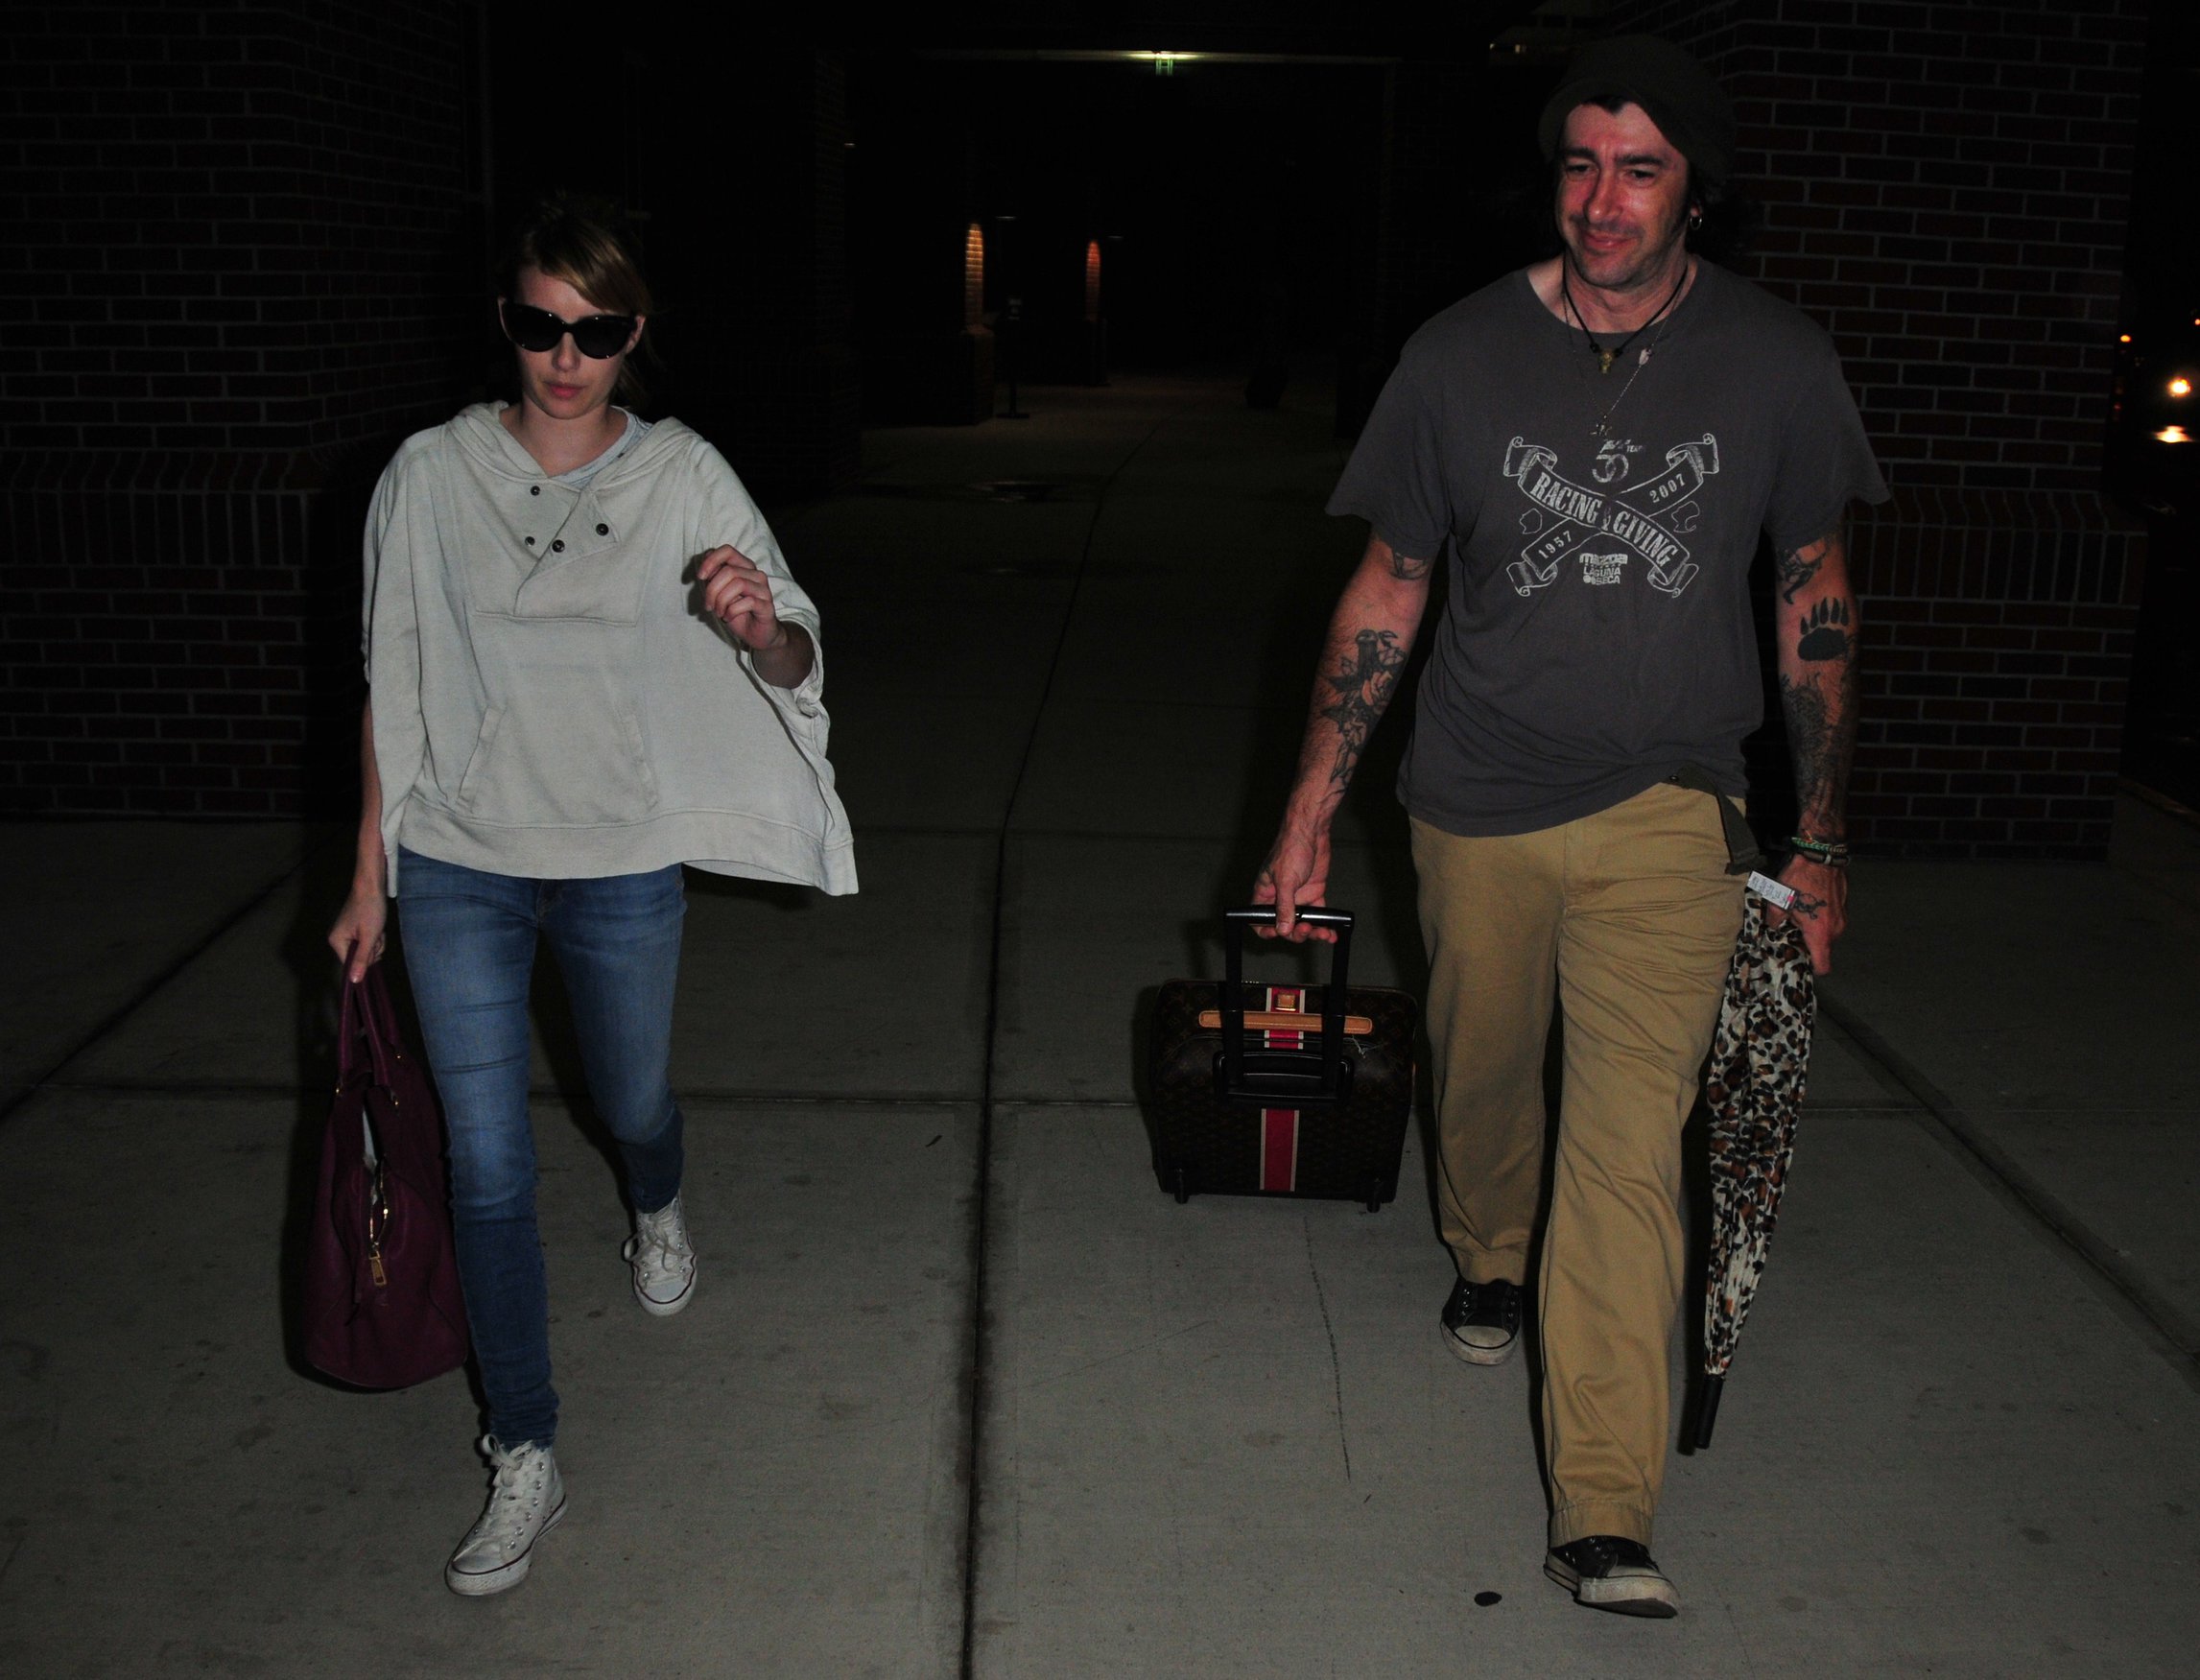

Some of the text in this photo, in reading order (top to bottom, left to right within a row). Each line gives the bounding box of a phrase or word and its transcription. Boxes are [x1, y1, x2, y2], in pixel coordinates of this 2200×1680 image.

[1649, 473, 1686, 504] 2007
[1529, 471, 1603, 525] RACING
[1613, 510, 1678, 567] GIVING
[1538, 530, 1572, 559] 1957
[1583, 565, 1621, 577] LAGUNA
